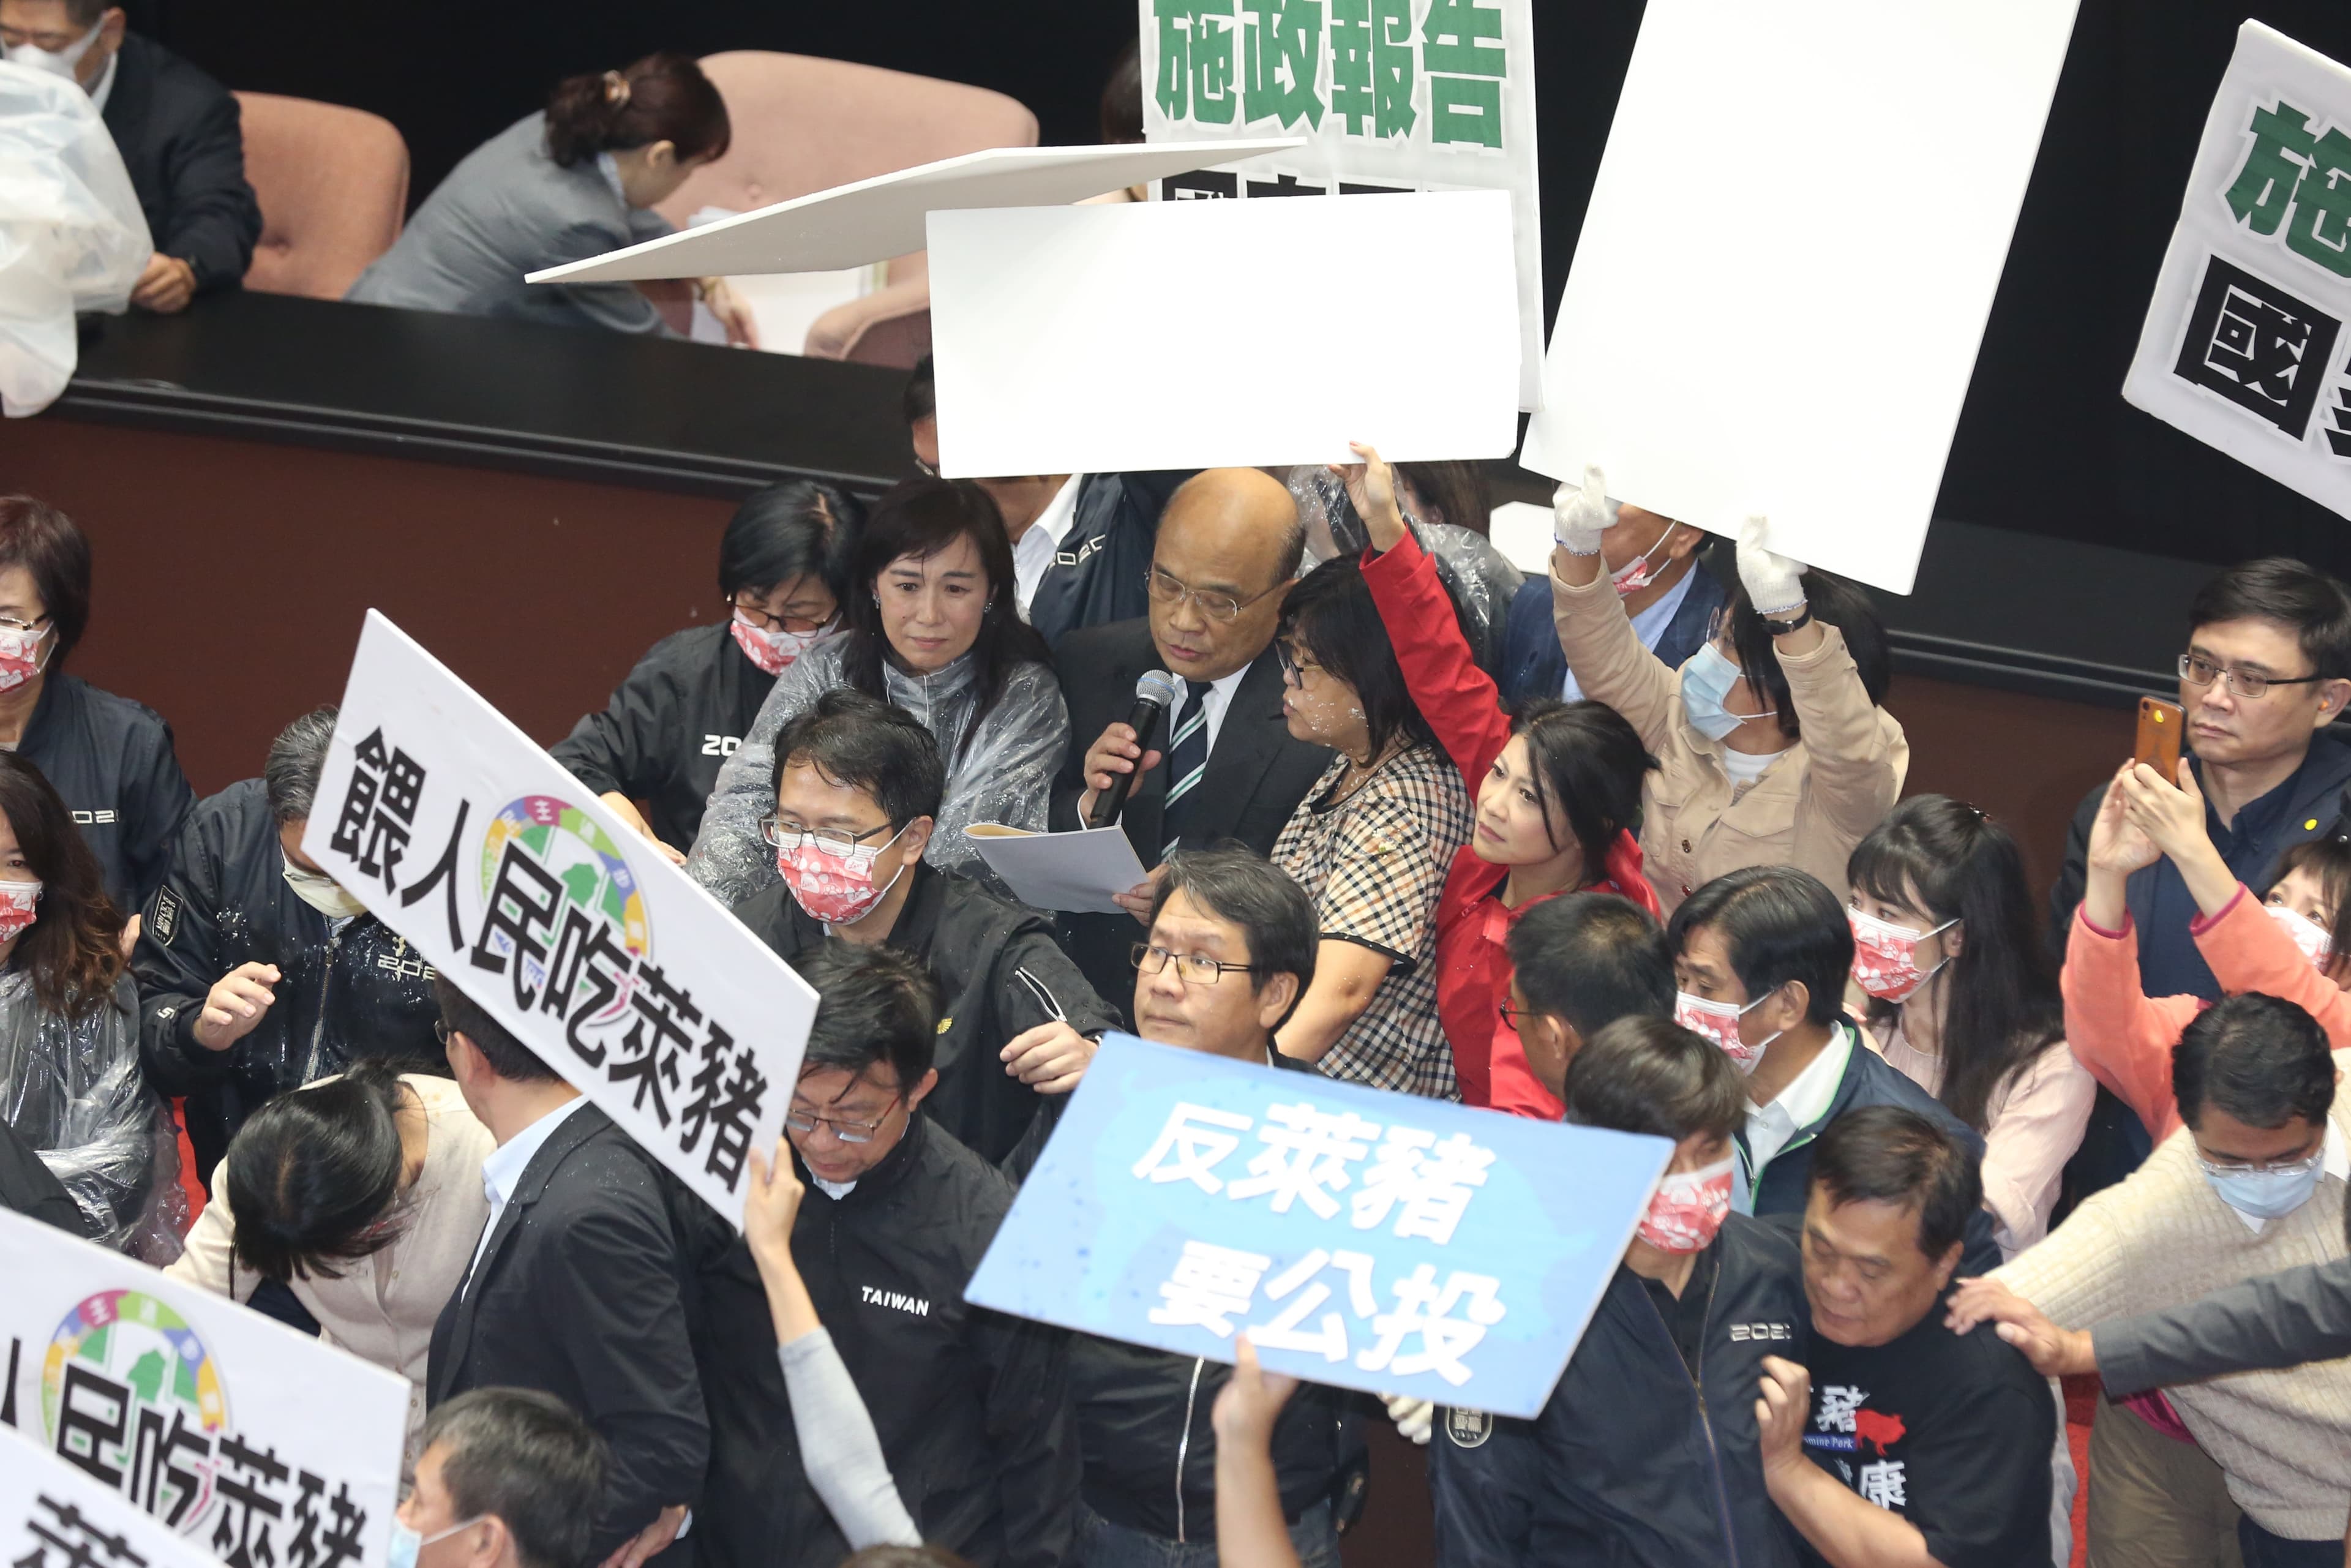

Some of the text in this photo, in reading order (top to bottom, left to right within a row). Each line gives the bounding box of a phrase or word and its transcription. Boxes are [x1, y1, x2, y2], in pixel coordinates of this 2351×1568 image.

[1153, 0, 1507, 149] 施政報告
[2173, 254, 2351, 458] 國
[330, 726, 768, 1195] 餵人民吃萊豬
[1131, 1102, 1496, 1245] 反萊豬
[862, 1286, 929, 1316] TAIWAN
[1149, 1240, 1507, 1387] 要公投
